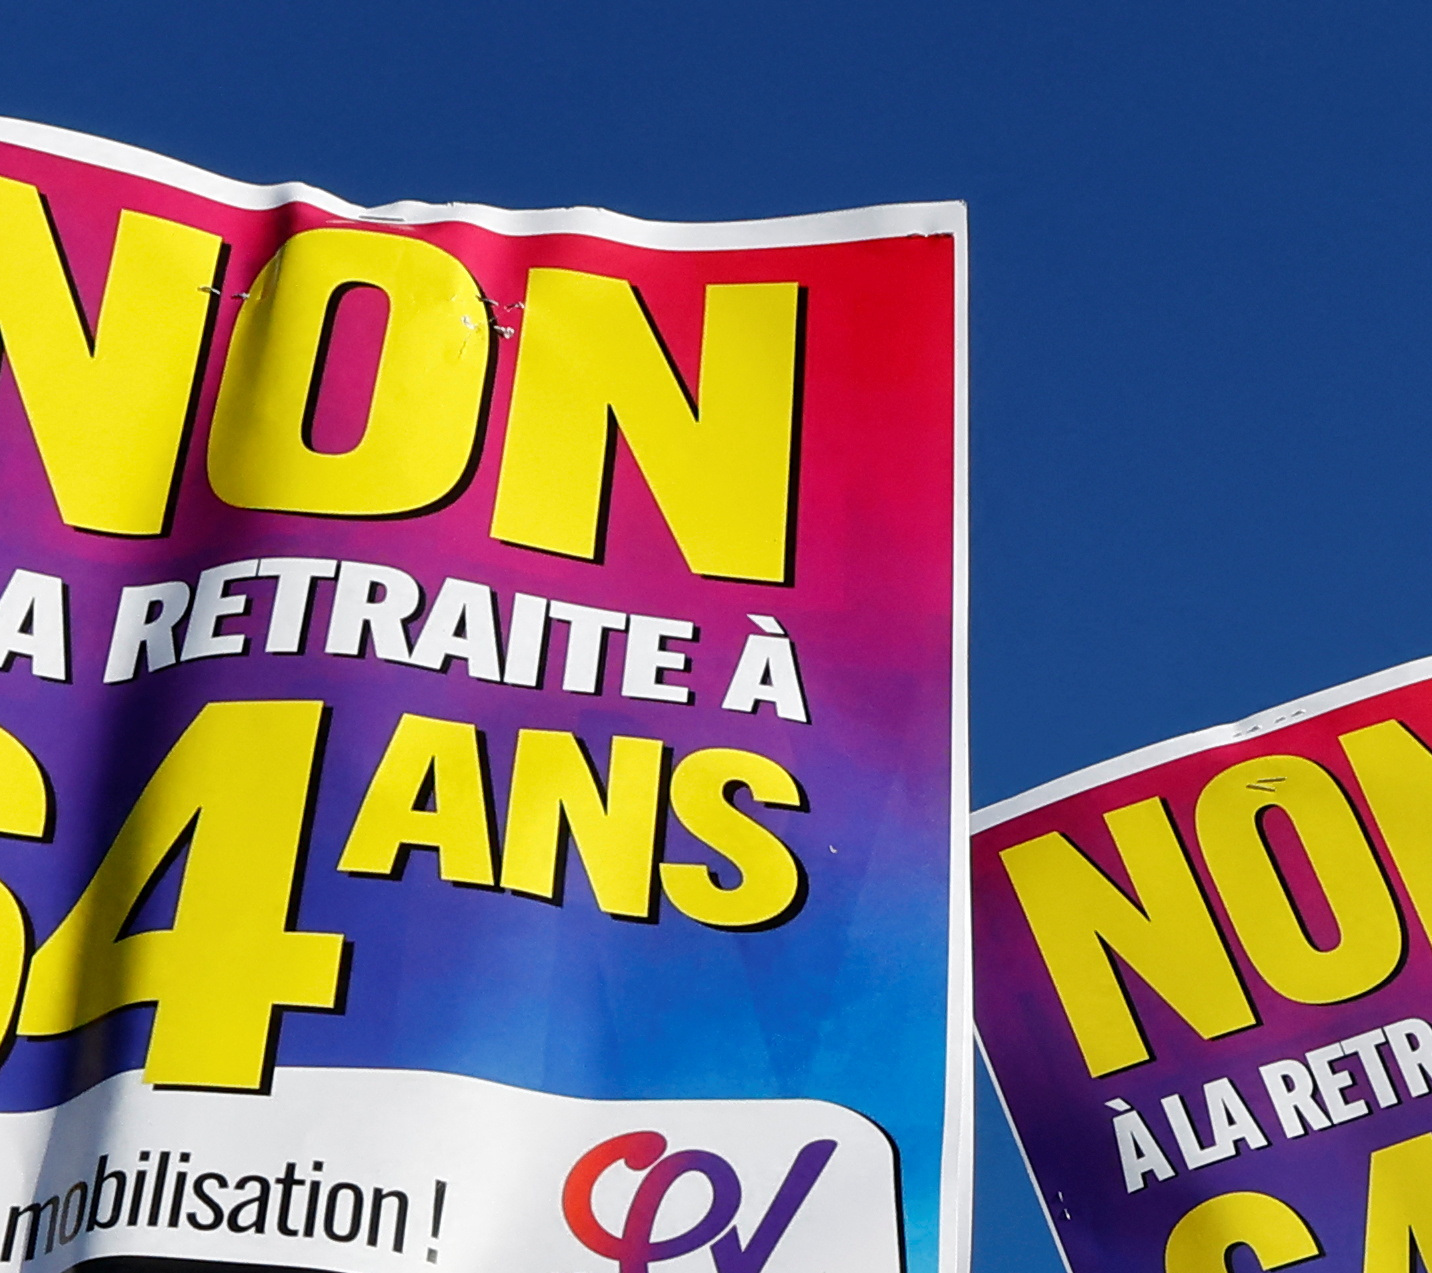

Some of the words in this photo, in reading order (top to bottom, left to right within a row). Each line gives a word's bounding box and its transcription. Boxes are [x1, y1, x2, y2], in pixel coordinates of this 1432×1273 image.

[104, 557, 692, 705] RETRAITE
[723, 614, 808, 721] À
[338, 714, 802, 928] ANS
[1103, 1096, 1164, 1194] À
[1161, 1083, 1266, 1171] LA
